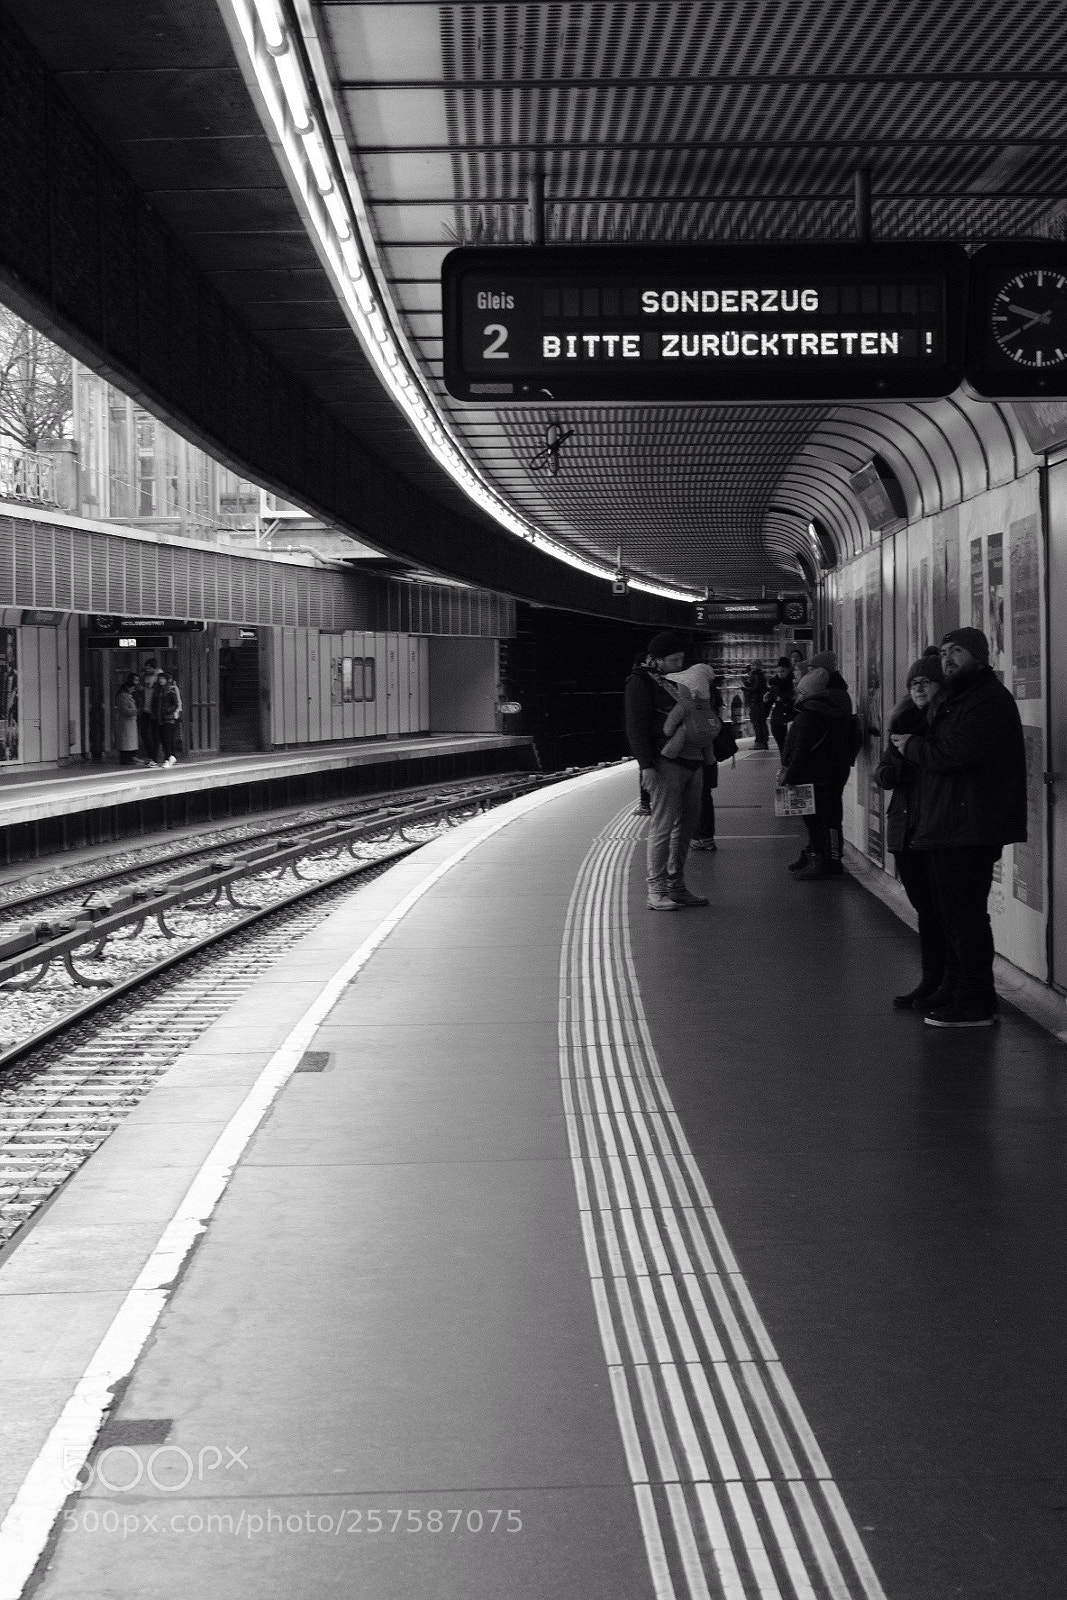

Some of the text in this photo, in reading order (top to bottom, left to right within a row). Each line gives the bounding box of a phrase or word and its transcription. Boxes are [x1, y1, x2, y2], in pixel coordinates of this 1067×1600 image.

[477, 291, 515, 310] Gleis
[641, 289, 819, 313] SONDERZUG
[482, 323, 510, 359] 2
[542, 330, 932, 358] BITTE ZURÜCKTRETEN !
